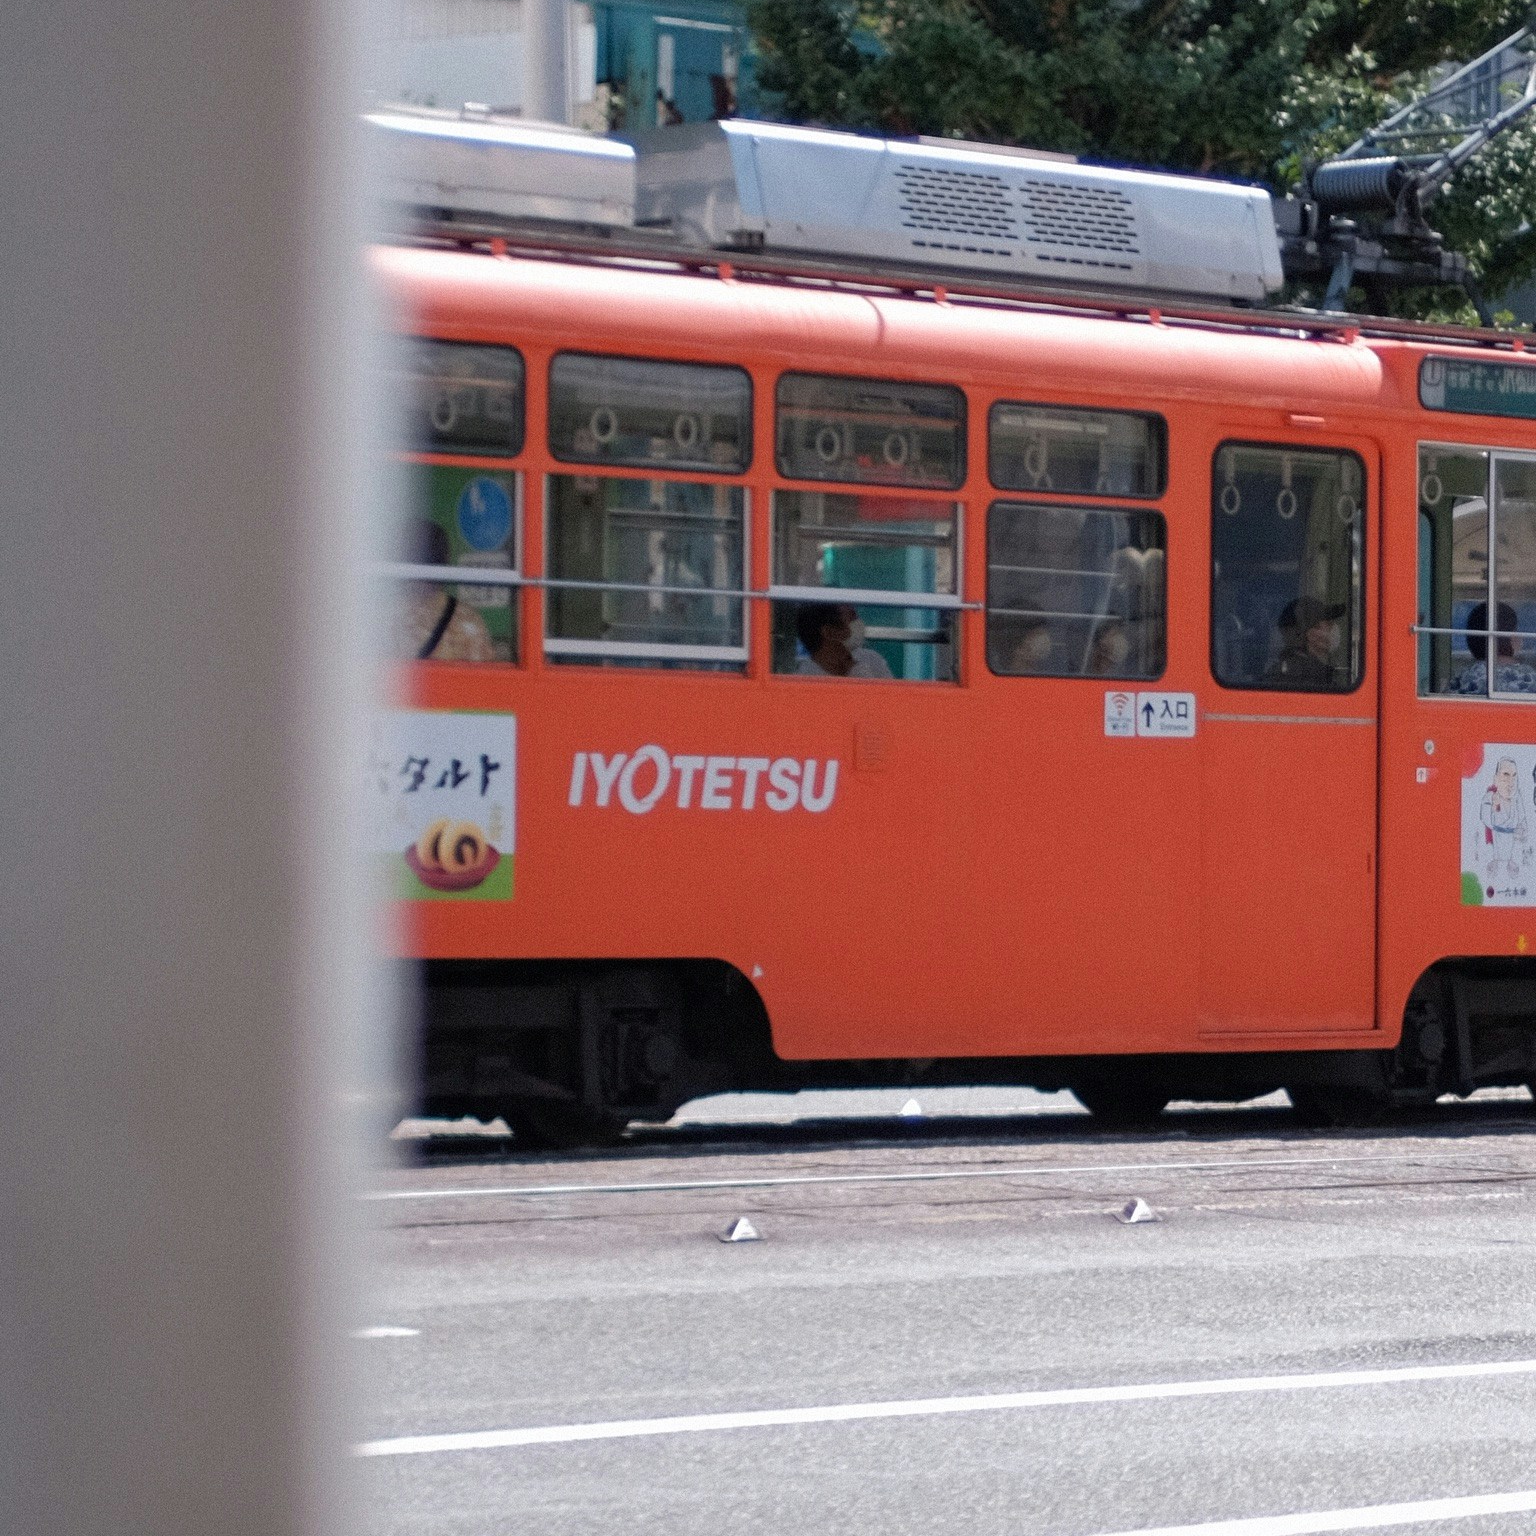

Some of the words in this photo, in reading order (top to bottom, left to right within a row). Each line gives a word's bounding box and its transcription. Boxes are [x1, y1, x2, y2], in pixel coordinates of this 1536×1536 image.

[1160, 700, 1188, 718] 入口
[366, 752, 500, 796] タルト
[568, 744, 838, 814] IYOTETSU
